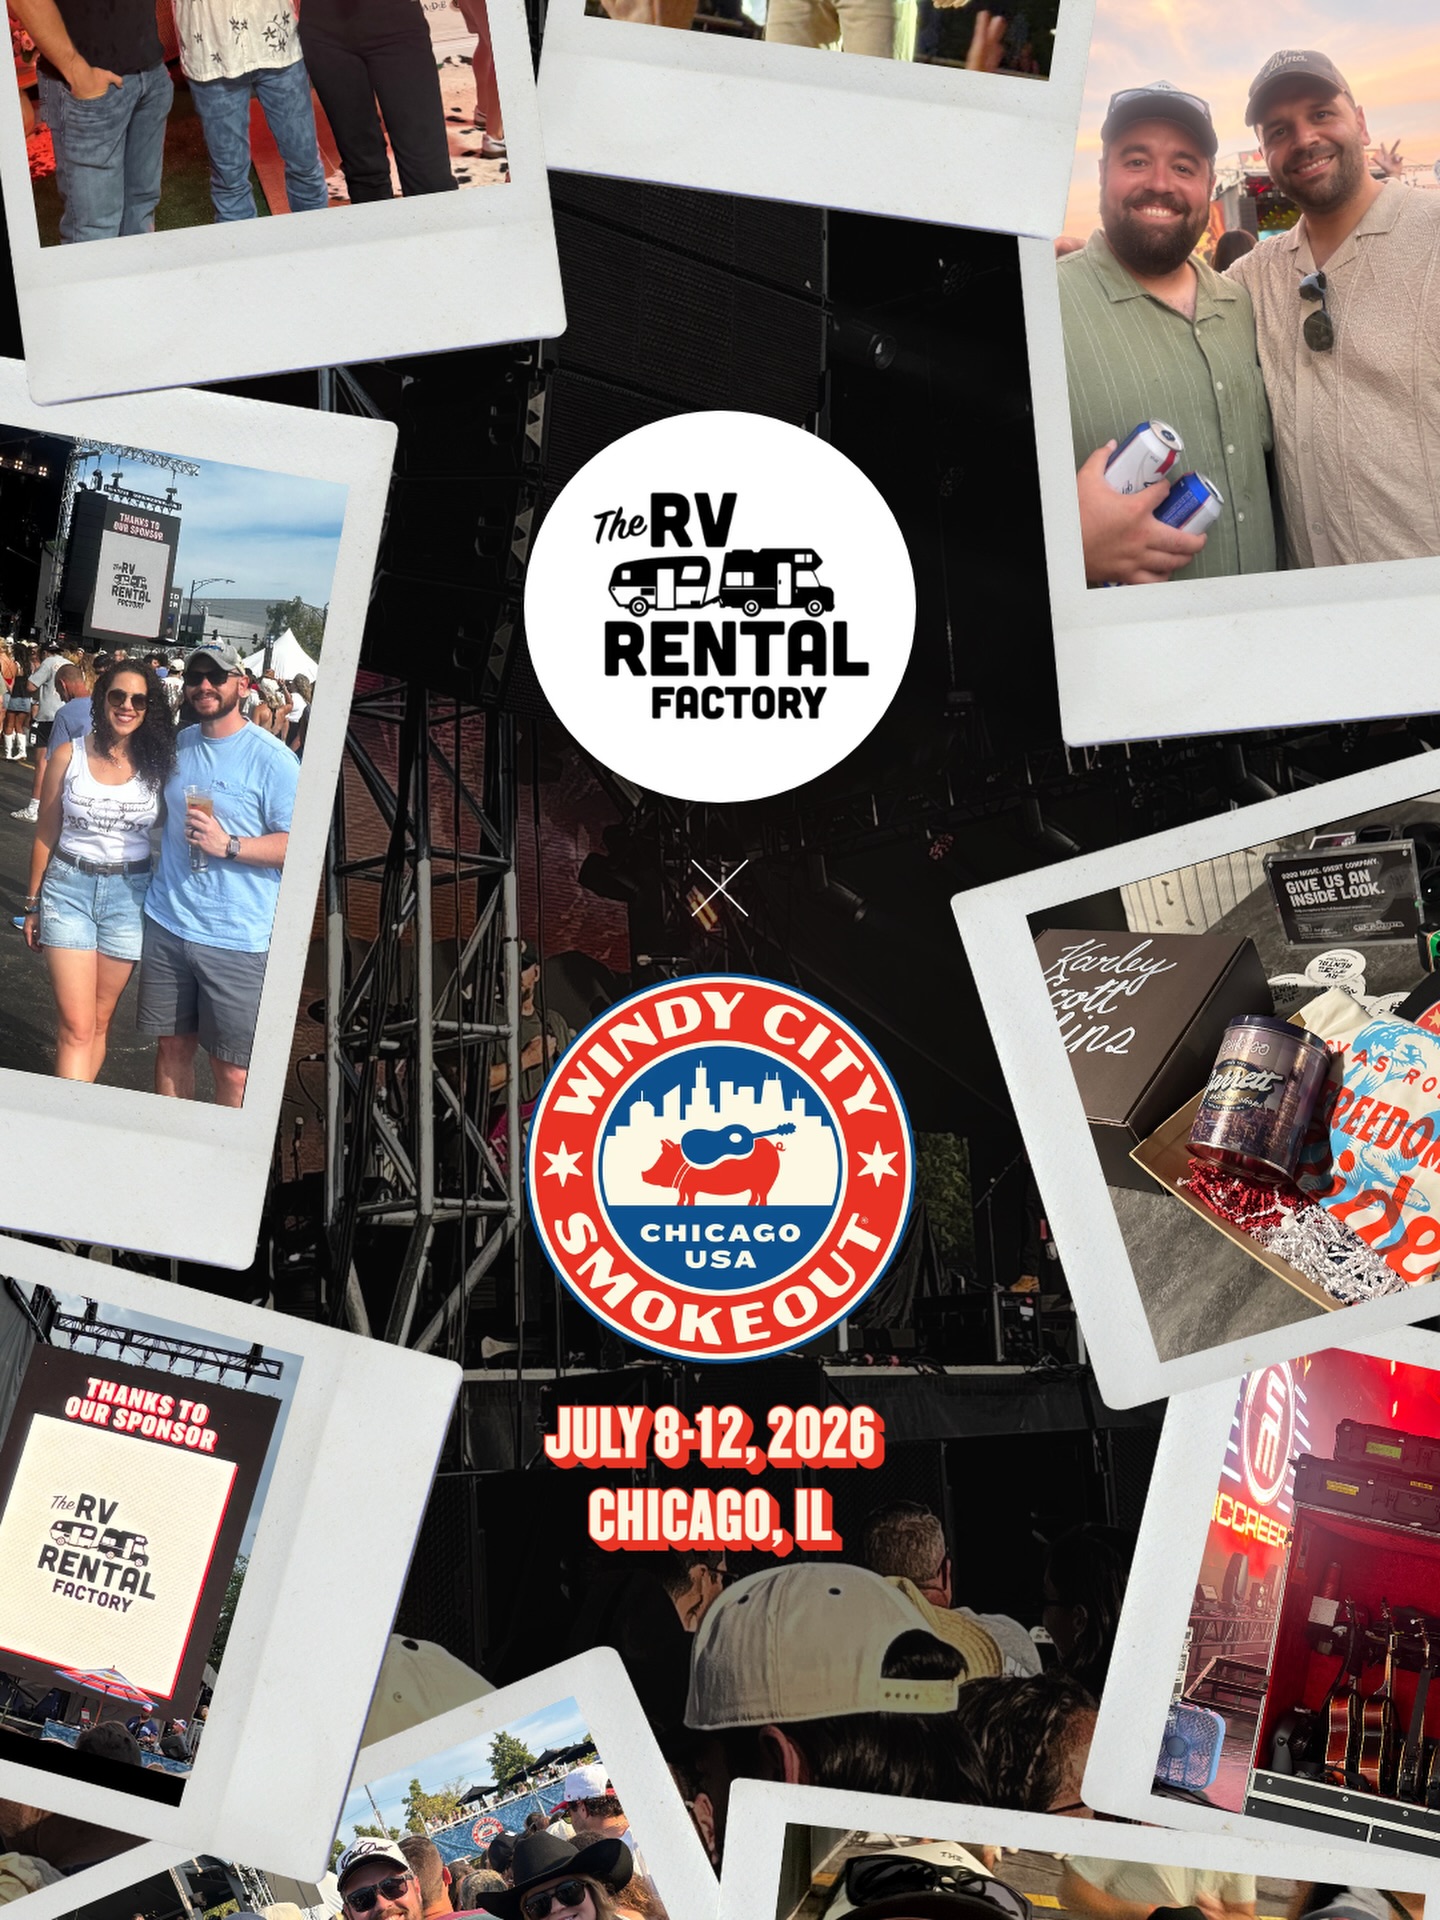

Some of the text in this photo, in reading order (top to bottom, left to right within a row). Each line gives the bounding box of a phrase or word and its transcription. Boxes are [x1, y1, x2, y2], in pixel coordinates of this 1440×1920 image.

[112, 520, 164, 541] OUR SPONSOR
[120, 512, 160, 530] THANKS TO
[121, 561, 136, 575] RV
[111, 585, 152, 603] RENTAL
[1285, 869, 1371, 894] GIVE US AN
[1289, 882, 1385, 907] INSIDE LOOK.
[1402, 1068, 1440, 1099] RO
[87, 1377, 210, 1426] THANKS TO
[64, 1396, 218, 1453] OUR SPONSOR
[50, 1492, 119, 1525] The RV
[37, 1543, 156, 1601] RENTAL
[52, 1578, 134, 1614] FACTORY
